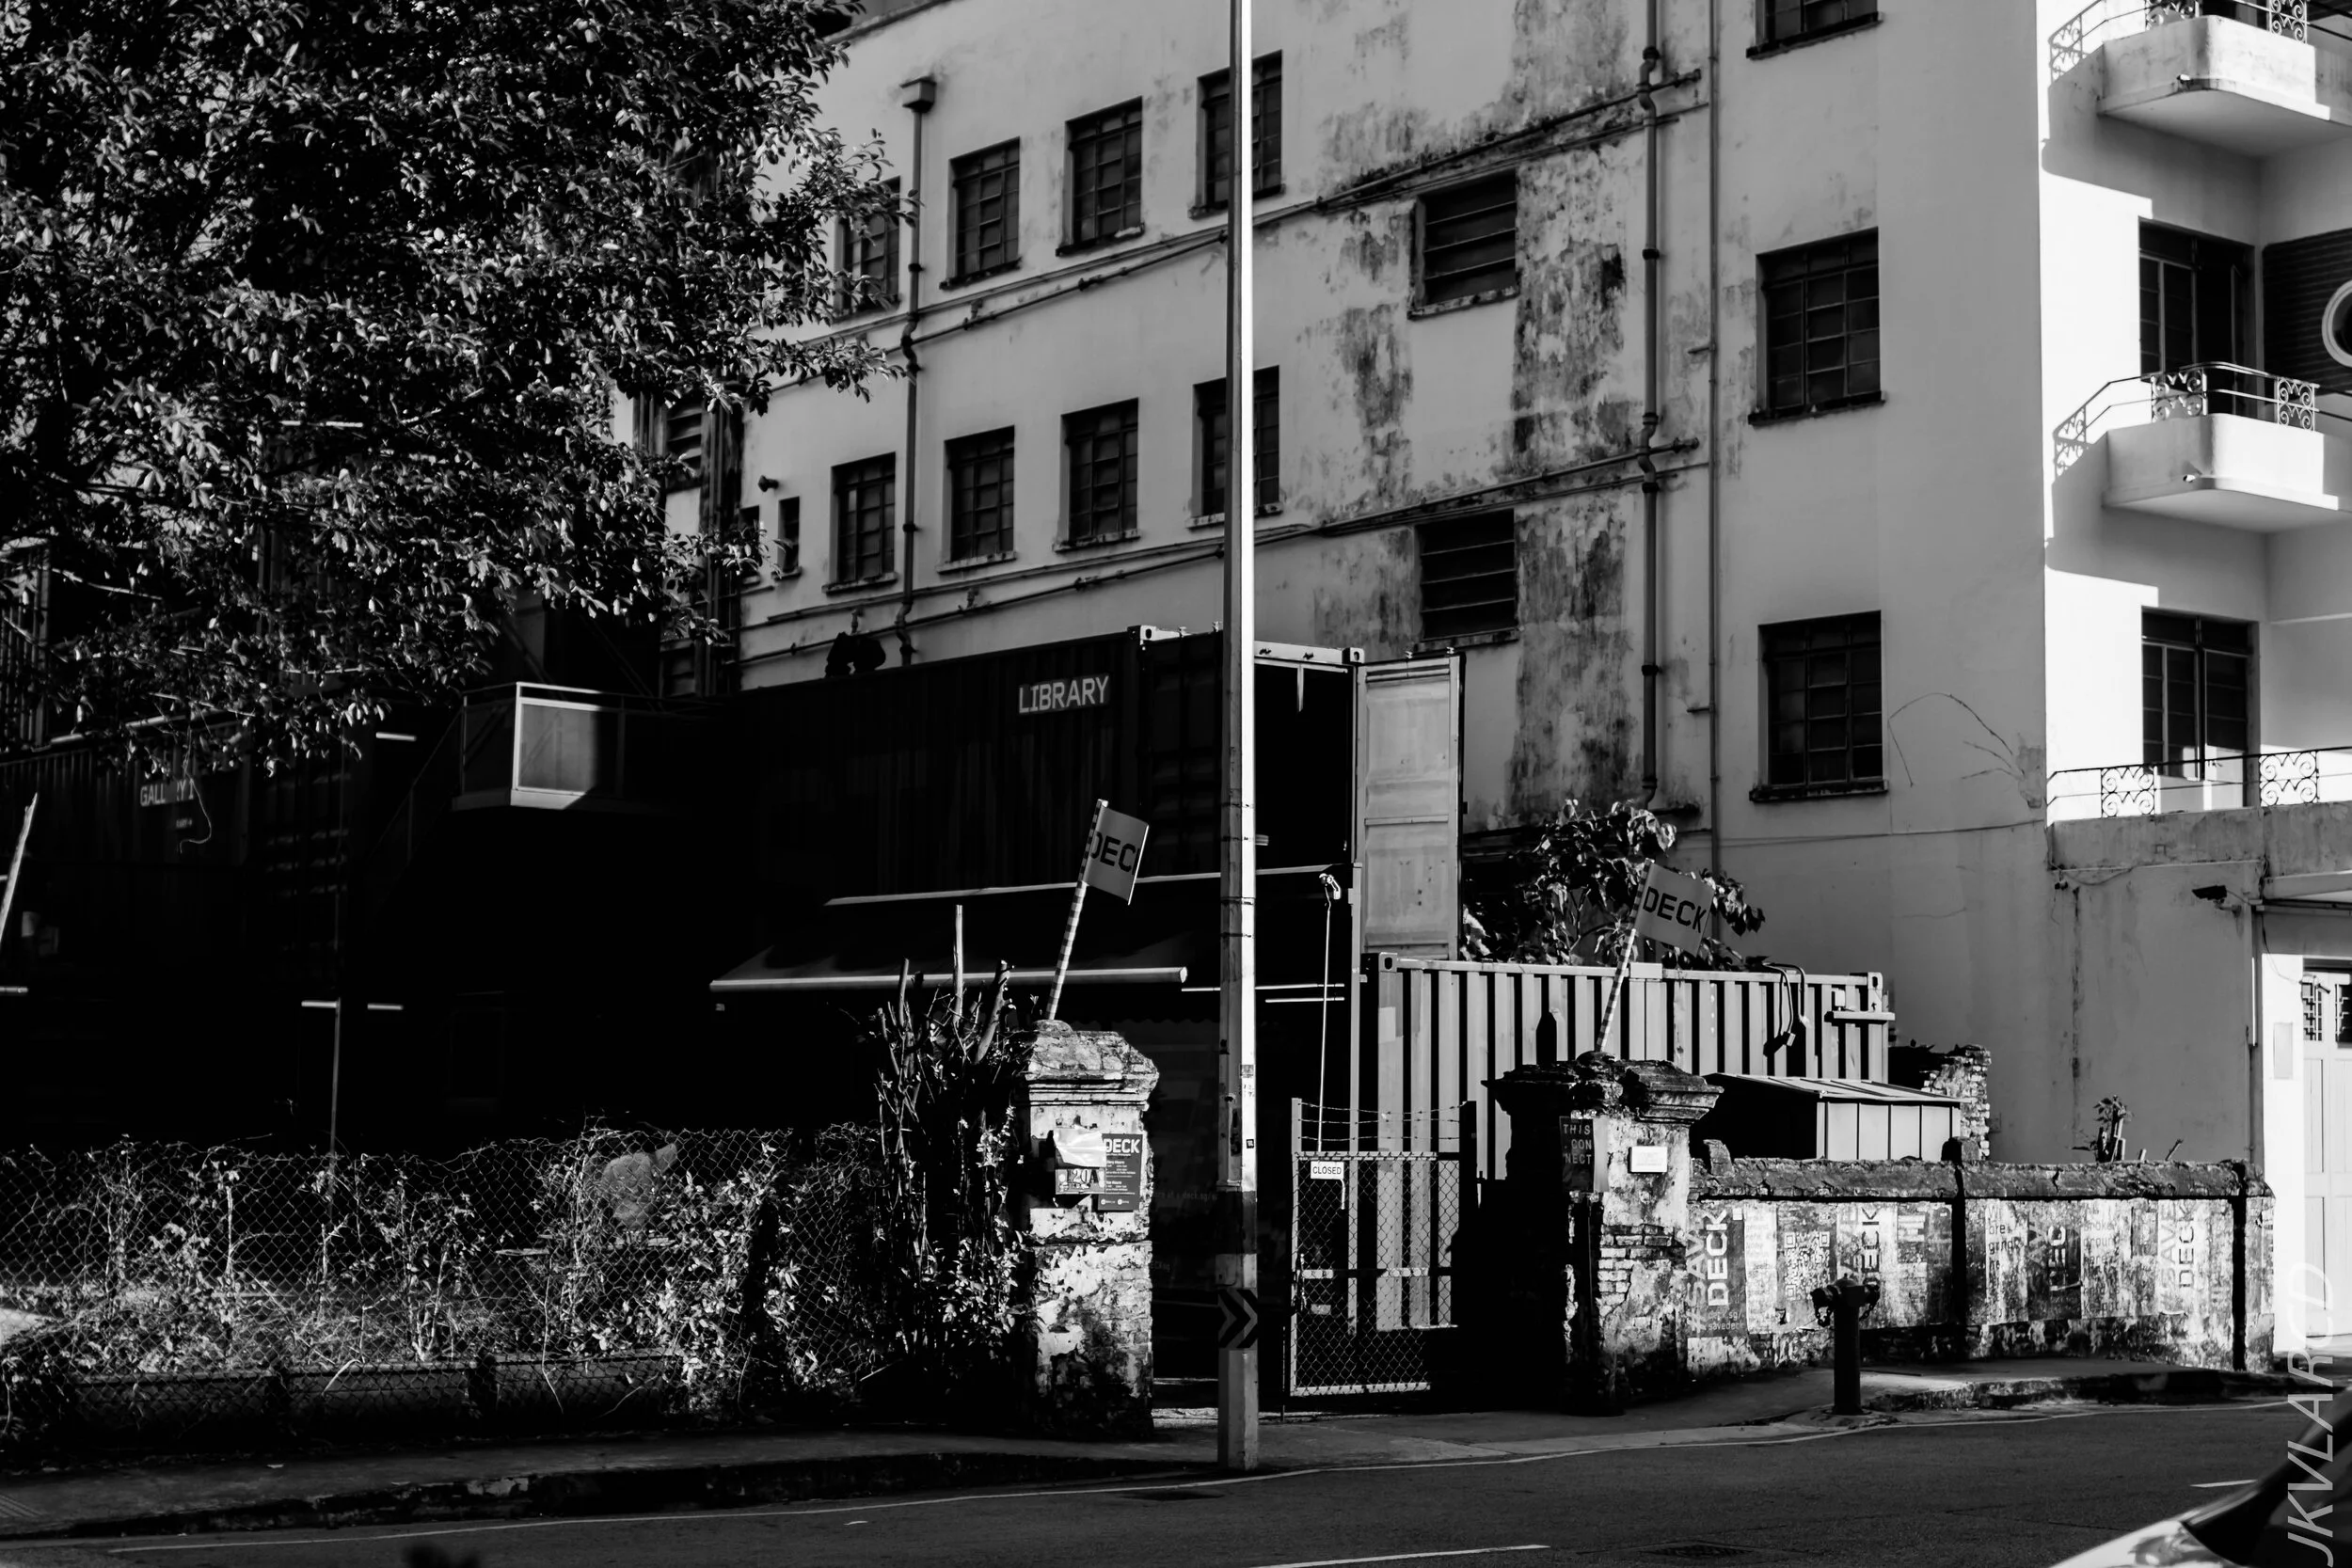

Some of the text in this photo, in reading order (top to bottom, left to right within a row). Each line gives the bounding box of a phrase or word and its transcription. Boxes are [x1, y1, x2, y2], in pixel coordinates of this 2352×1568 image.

[1019, 674, 1109, 714] LIBRARY
[139, 779, 187, 807] GALLY
[1643, 886, 1708, 933] DECK
[1563, 1123, 1591, 1134] THIS
[1104, 1138, 1140, 1153] DECK
[1571, 1139, 1593, 1150] CON
[1565, 1153, 1592, 1165] NECT
[1312, 1165, 1342, 1175] CLOSED
[1703, 1210, 1729, 1307] DECK
